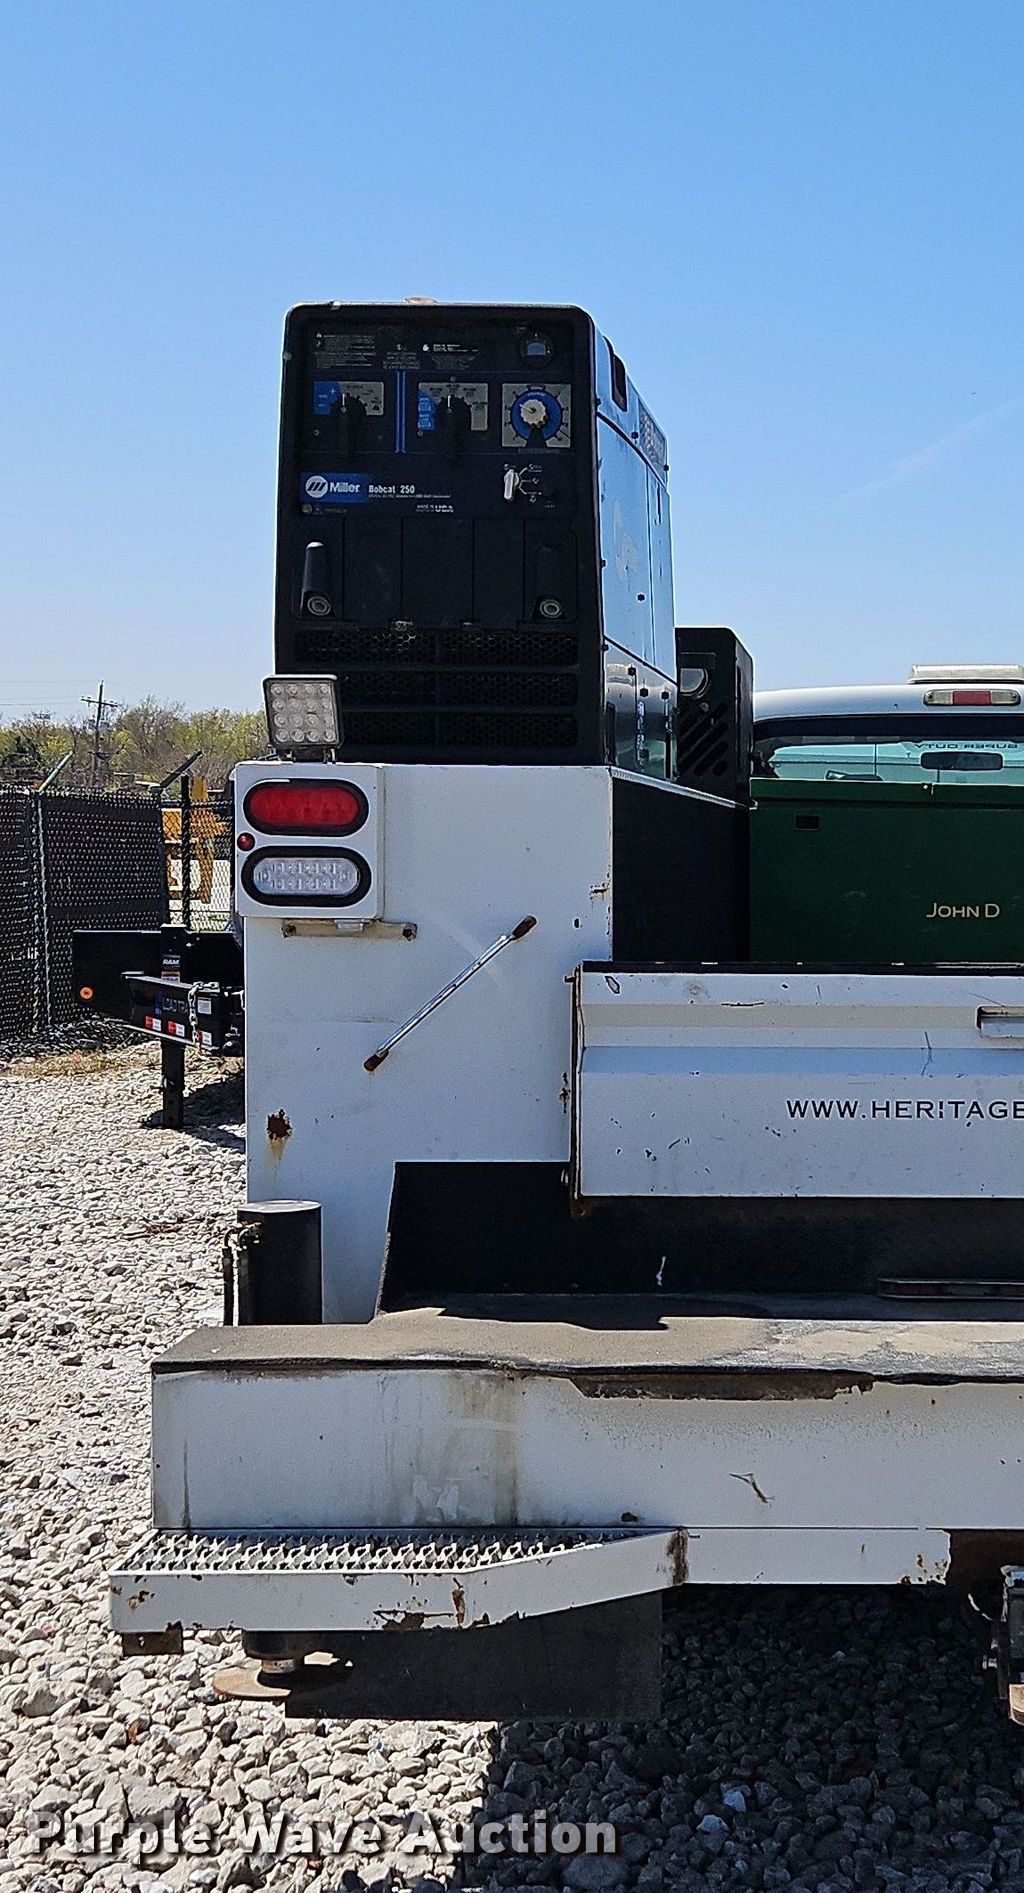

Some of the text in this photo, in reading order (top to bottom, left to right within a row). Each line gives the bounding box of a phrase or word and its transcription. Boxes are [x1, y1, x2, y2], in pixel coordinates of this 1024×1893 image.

[329, 482, 361, 493] Miller
[368, 485, 415, 494] Bobcat 250
